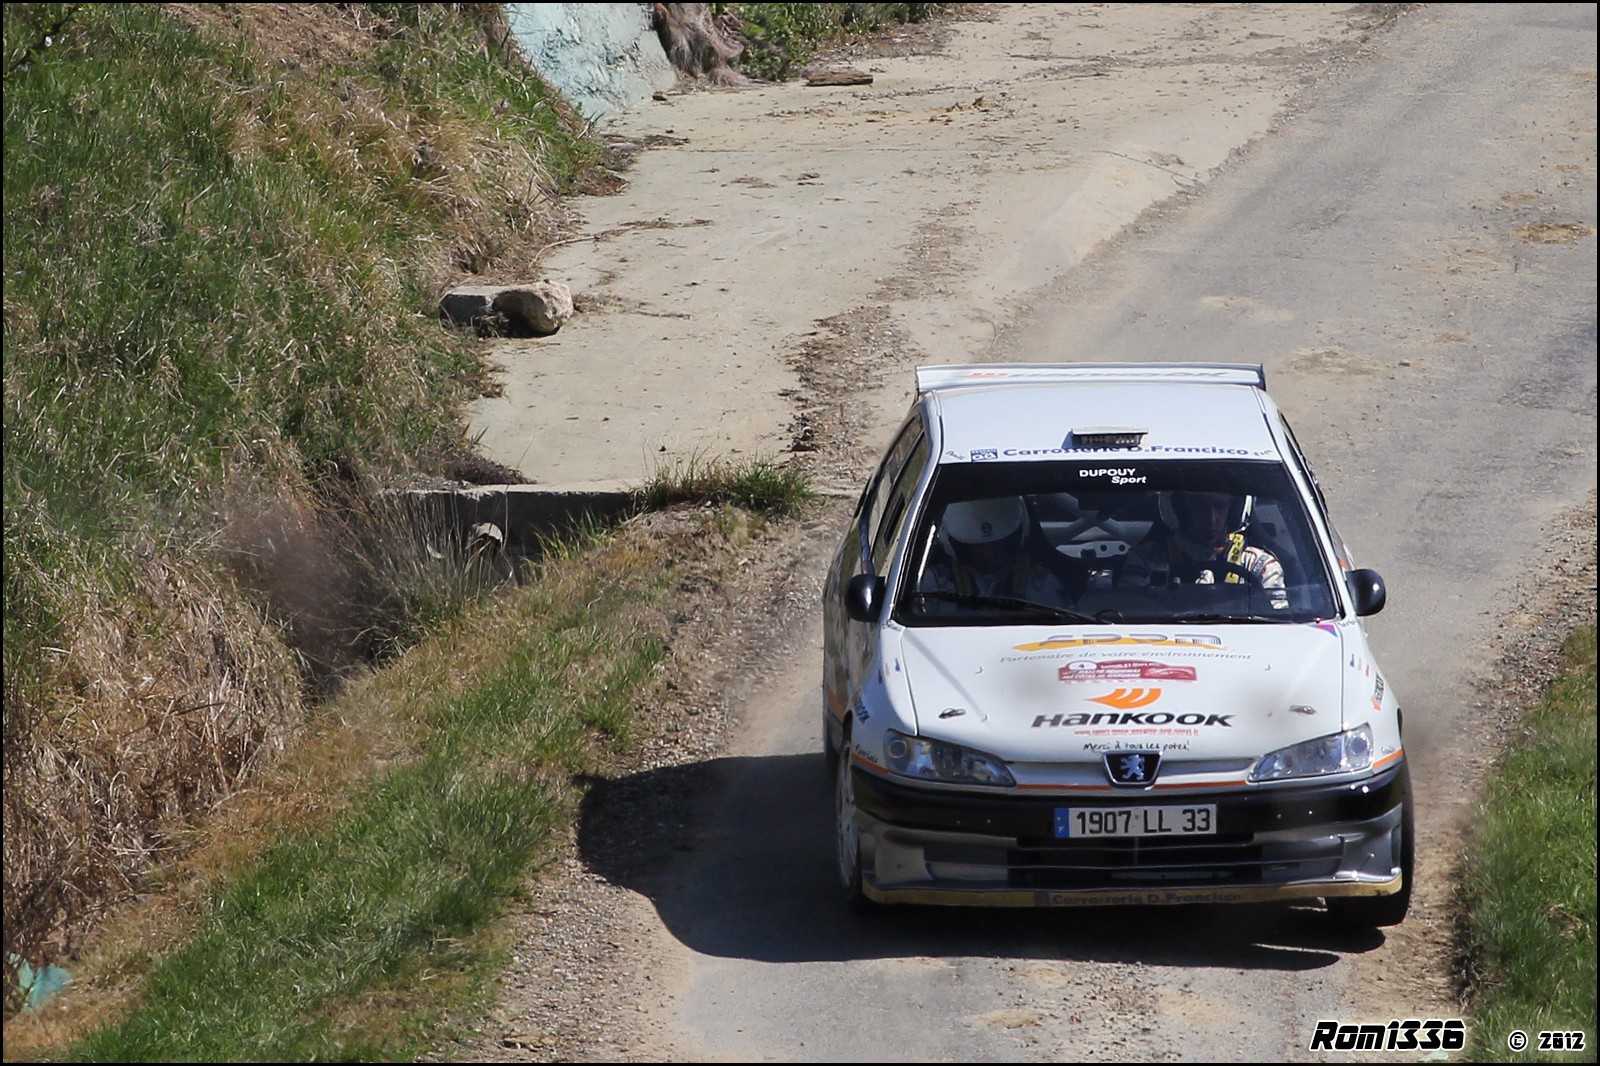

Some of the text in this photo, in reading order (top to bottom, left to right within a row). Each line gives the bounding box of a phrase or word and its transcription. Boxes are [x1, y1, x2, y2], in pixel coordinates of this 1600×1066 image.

[1079, 468, 1136, 477] DUPOUY
[1111, 476, 1147, 485] Sport
[1000, 653, 1073, 663] Partenaire
[1142, 651, 1251, 660] environnement
[1083, 742, 1110, 751] Merci
[1114, 740, 1121, 749] à
[1076, 810, 1132, 834] 1907
[1144, 809, 1172, 834] LL
[1182, 808, 1211, 832] 33
